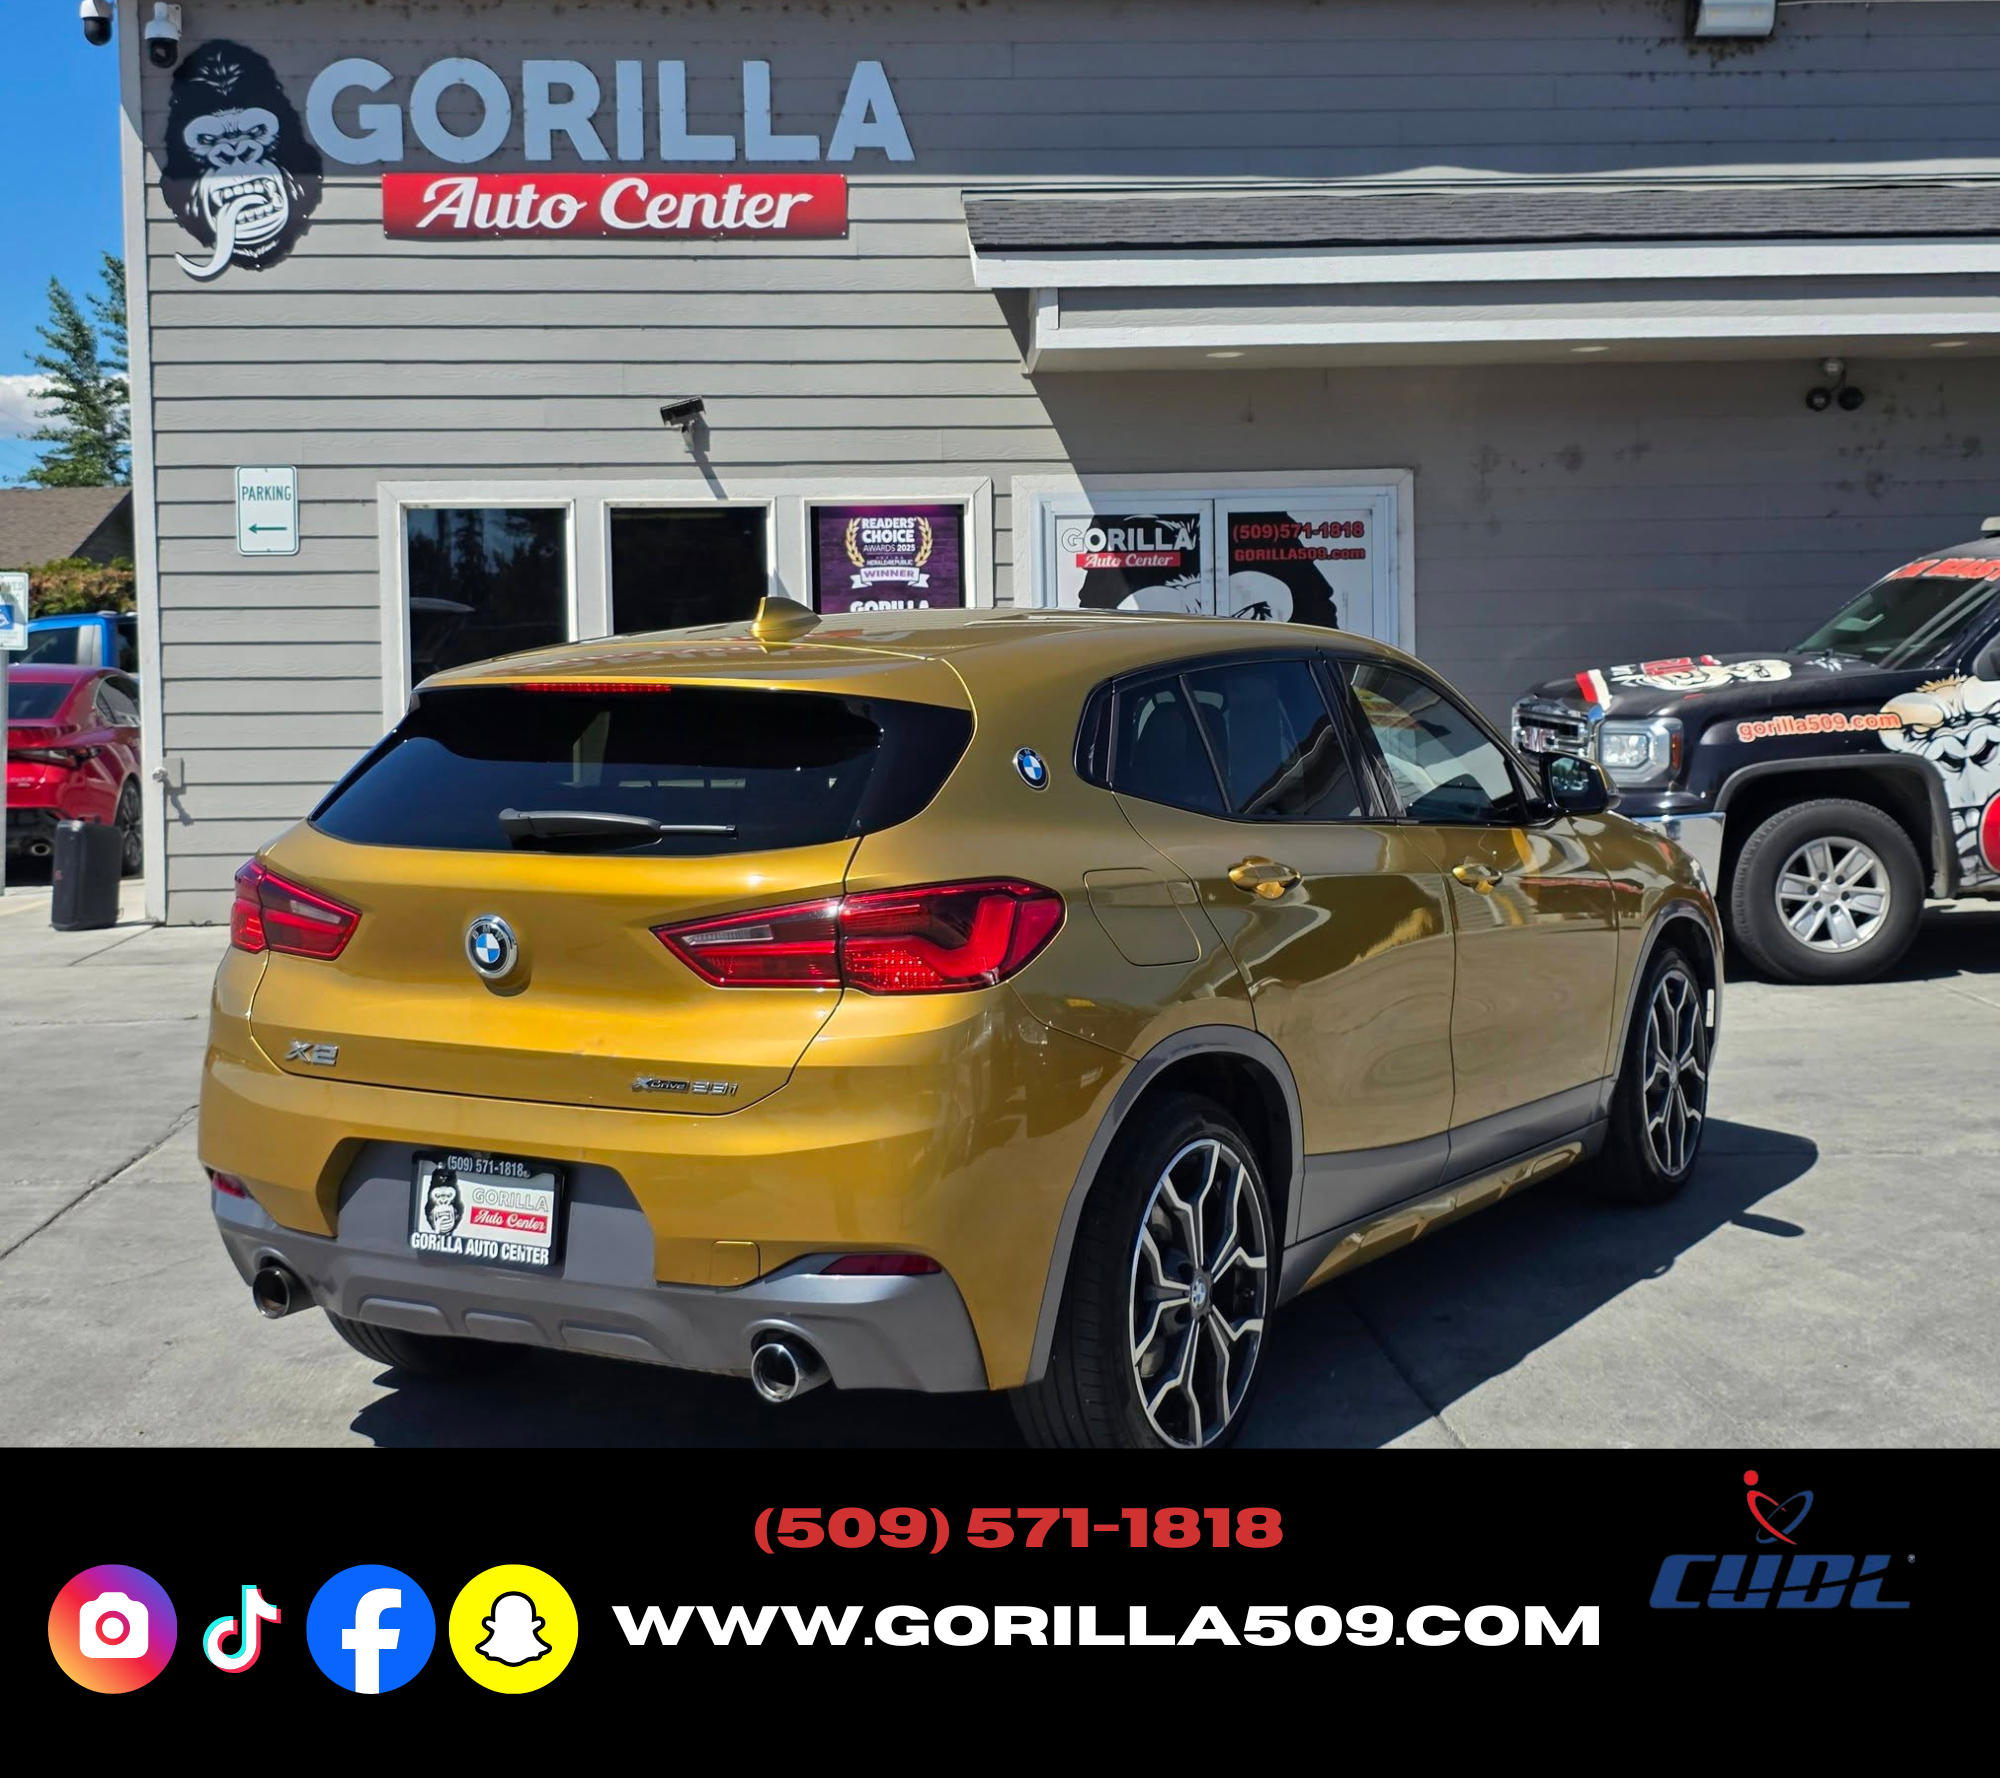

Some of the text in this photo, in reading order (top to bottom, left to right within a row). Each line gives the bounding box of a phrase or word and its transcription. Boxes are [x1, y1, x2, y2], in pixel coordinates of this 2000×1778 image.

[305, 57, 915, 164] GORILLA
[414, 176, 814, 230] Auto Center
[241, 485, 292, 501] PARKING
[862, 529, 915, 543] CHOICE
[1061, 527, 1194, 553] GORILLA
[1233, 521, 1365, 543] (509)571-1818
[863, 544, 916, 552] AWARDS 2025
[1234, 547, 1367, 562] GORILLA509.com
[1083, 553, 1173, 568] Auto Center
[863, 568, 915, 578] WINNER
[1737, 711, 1902, 743] gorilla509.com
[472, 924, 504, 941] BMW
[285, 1041, 338, 1066] X2
[447, 1156, 524, 1177] (509) 571-1818
[472, 1188, 549, 1213] GORILLA
[474, 1210, 546, 1231] Auto Center
[465, 1238, 498, 1259] AUTO
[501, 1243, 550, 1265] CENTER
